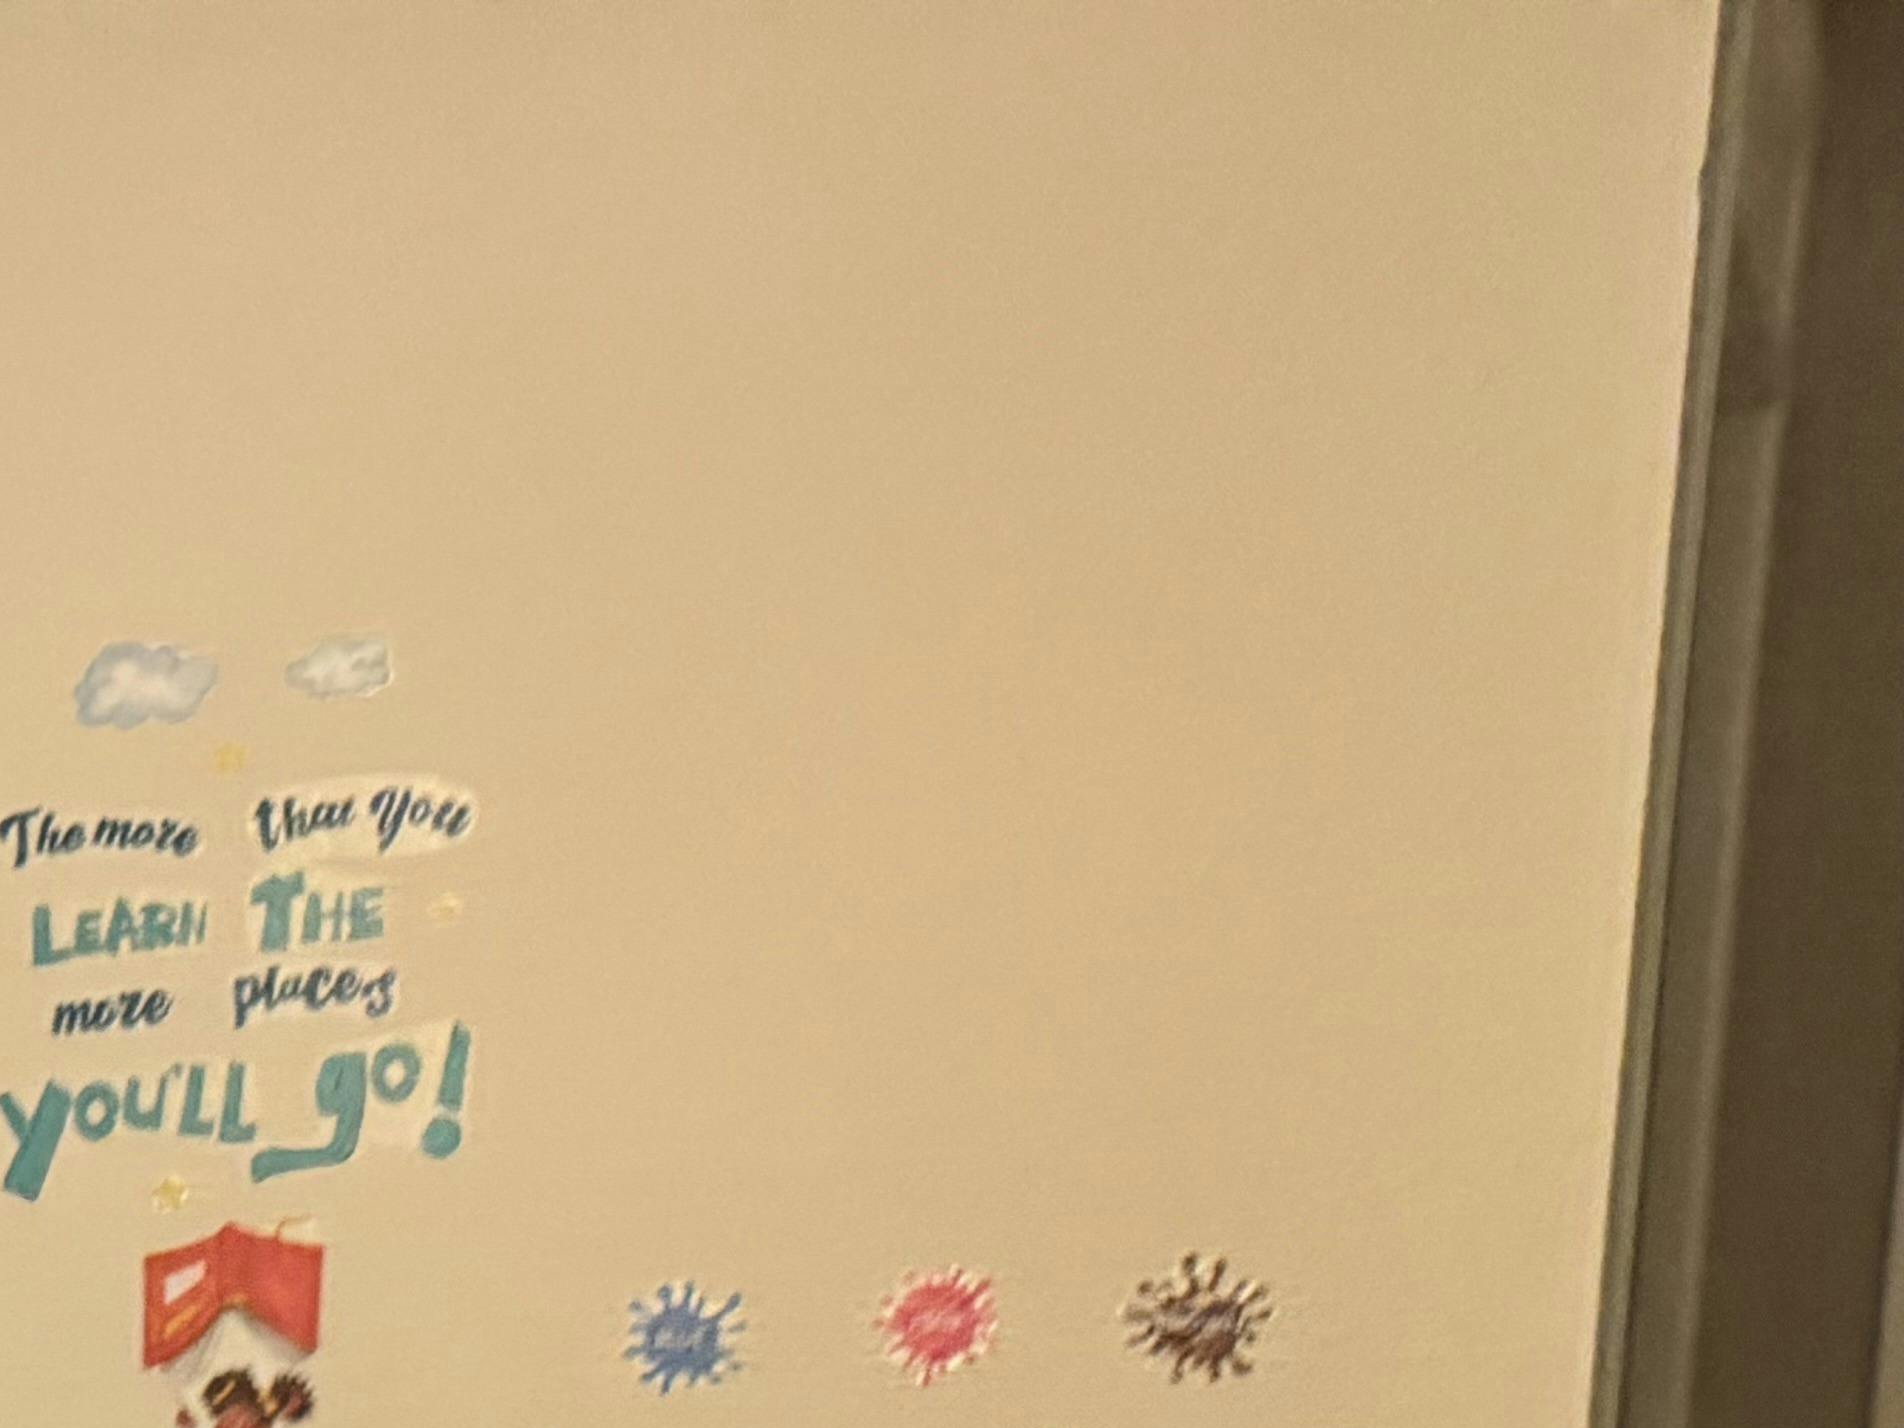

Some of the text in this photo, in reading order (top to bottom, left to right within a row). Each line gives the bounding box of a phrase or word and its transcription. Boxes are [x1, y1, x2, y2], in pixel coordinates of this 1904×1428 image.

[94, 817, 199, 857] more
[370, 785, 471, 855] You
[52, 964, 398, 1037] more places
